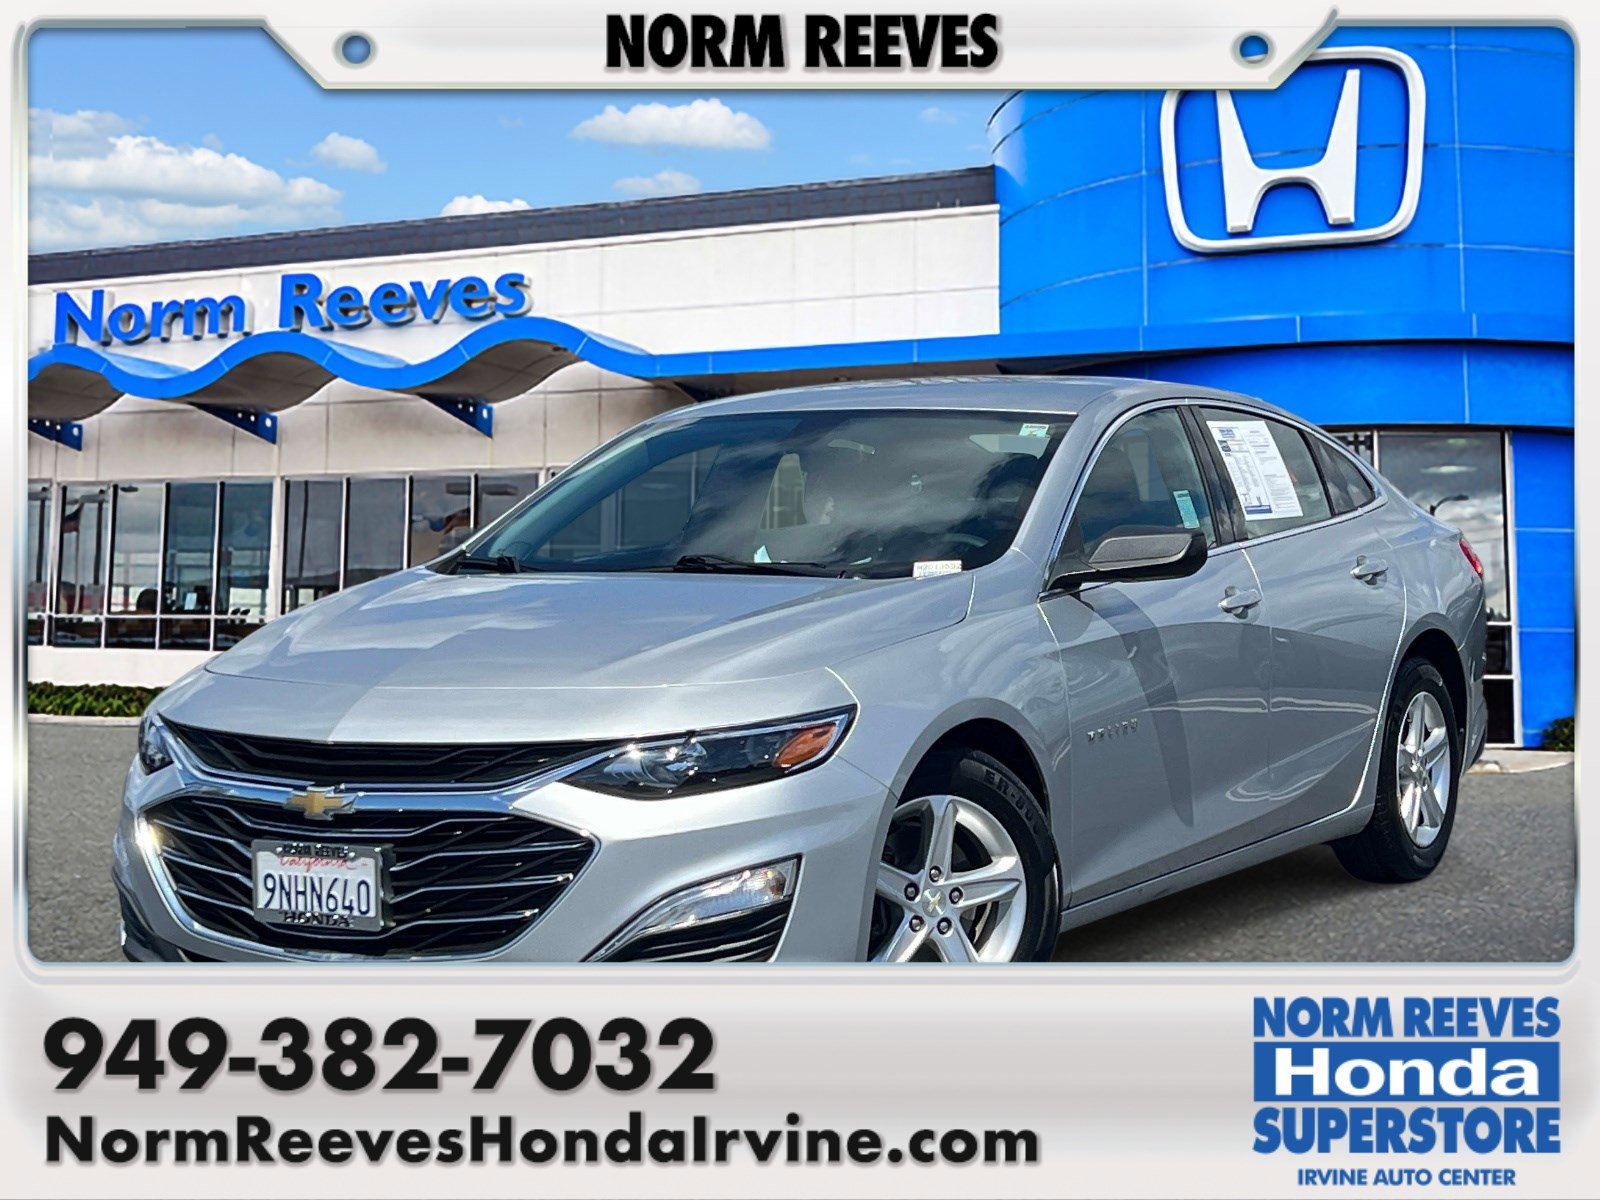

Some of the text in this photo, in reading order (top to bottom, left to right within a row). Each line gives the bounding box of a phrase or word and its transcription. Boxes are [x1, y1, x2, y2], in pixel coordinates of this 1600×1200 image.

[54, 272, 530, 345] Norm Reeves
[263, 872, 370, 916] 9NHN640
